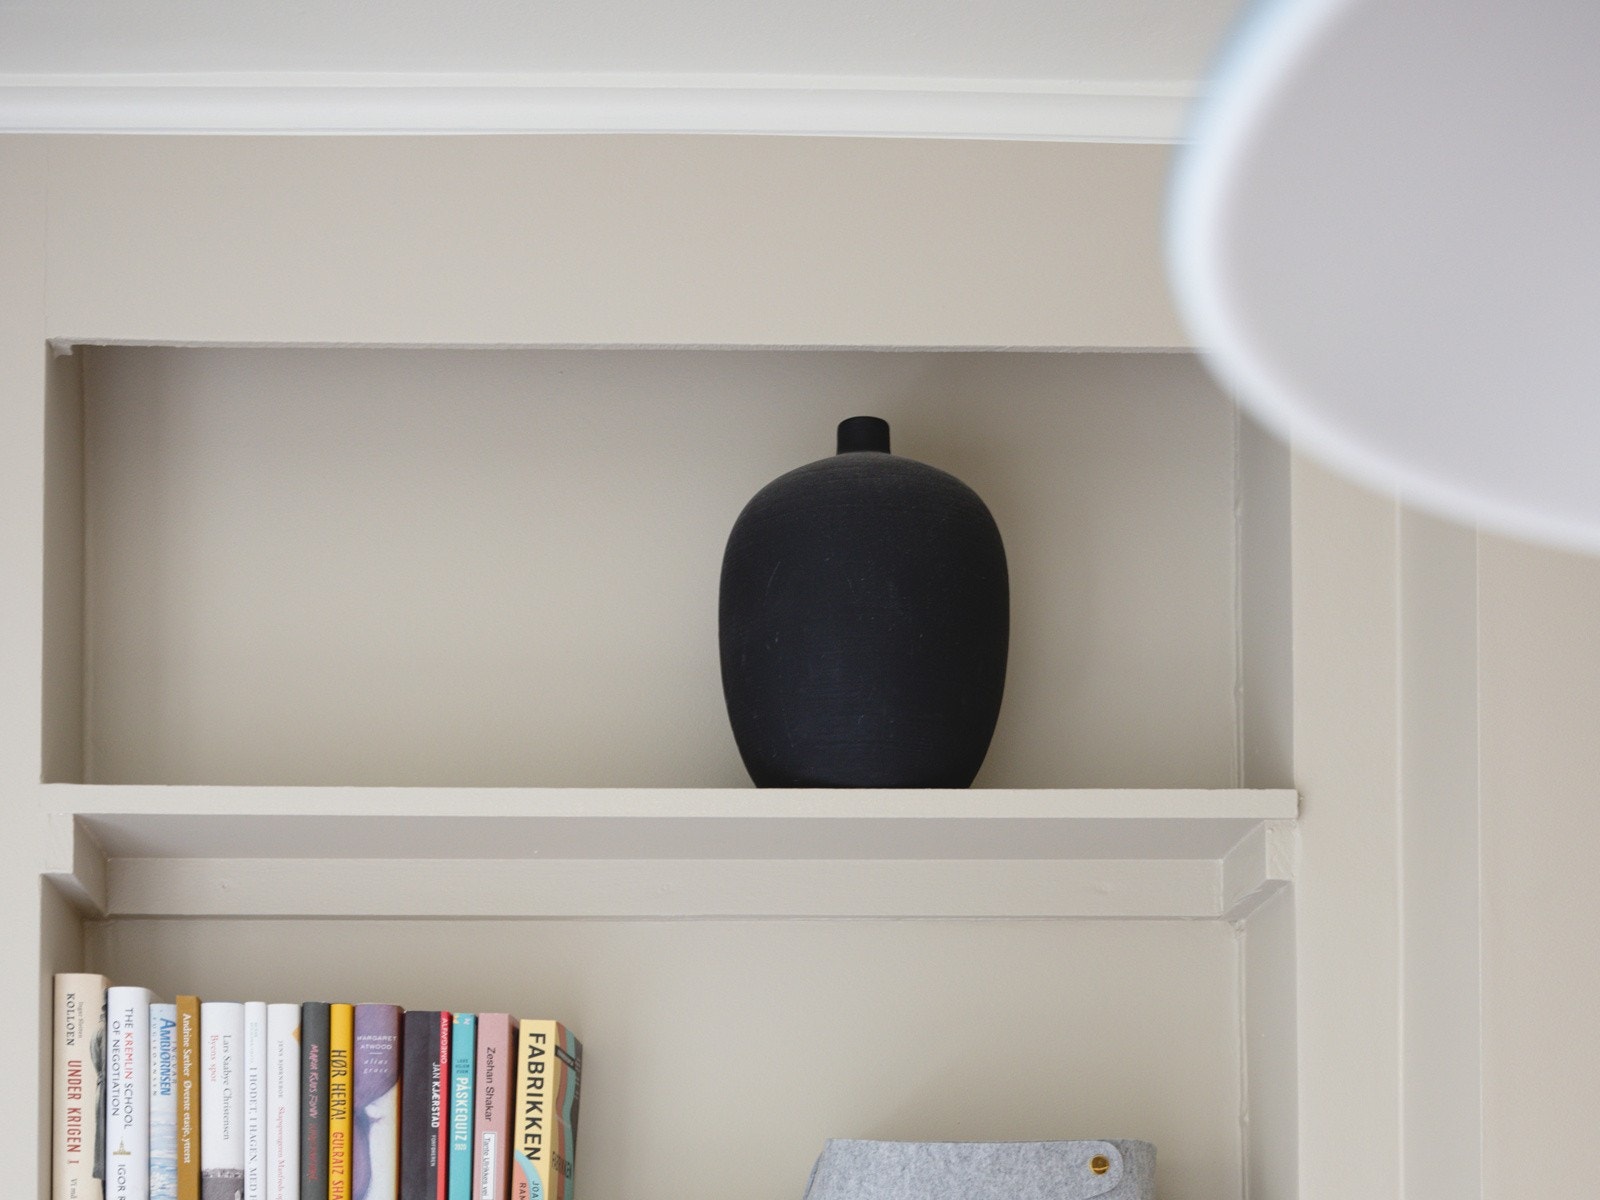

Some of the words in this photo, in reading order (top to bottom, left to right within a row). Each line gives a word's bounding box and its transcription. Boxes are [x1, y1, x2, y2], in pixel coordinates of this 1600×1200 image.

[66, 993, 75, 1046] KOLLOEN
[112, 1020, 120, 1036] OF
[124, 1008, 133, 1029] THE
[182, 1013, 192, 1048] Andrine
[124, 1032, 133, 1079] KREMLIN
[160, 1017, 176, 1096] AMBJØRNSEN
[209, 1035, 219, 1060] Byens
[223, 1035, 232, 1053] Lars
[111, 1039, 120, 1116] NEGOTIATION
[182, 1049, 191, 1077] Sæther
[221, 1055, 231, 1085] Saabye
[331, 1050, 348, 1078] HØR
[432, 1062, 440, 1078] JAN
[485, 1047, 496, 1084] Zeshan
[67, 1060, 81, 1100] UNDER
[182, 1080, 192, 1111] Øverste
[124, 1083, 133, 1129] SCHOOL
[431, 1081, 440, 1128] KJÆRSTAD
[454, 1077, 470, 1141] PÅSKEQUIZ
[484, 1086, 495, 1122] Shakar
[524, 1033, 546, 1161] FABRIKKEN
[67, 1107, 81, 1153] KRIGEN
[182, 1113, 192, 1136] etasje,
[223, 1088, 232, 1140] Christensen
[180, 1137, 191, 1163] ytterst
[331, 1132, 344, 1175] GULRAIZ
[70, 1178, 77, 1186] Vi
[117, 1164, 126, 1192] IGOR
[249, 1168, 258, 1192] MED
[482, 1157, 490, 1185] Ulrikkes
